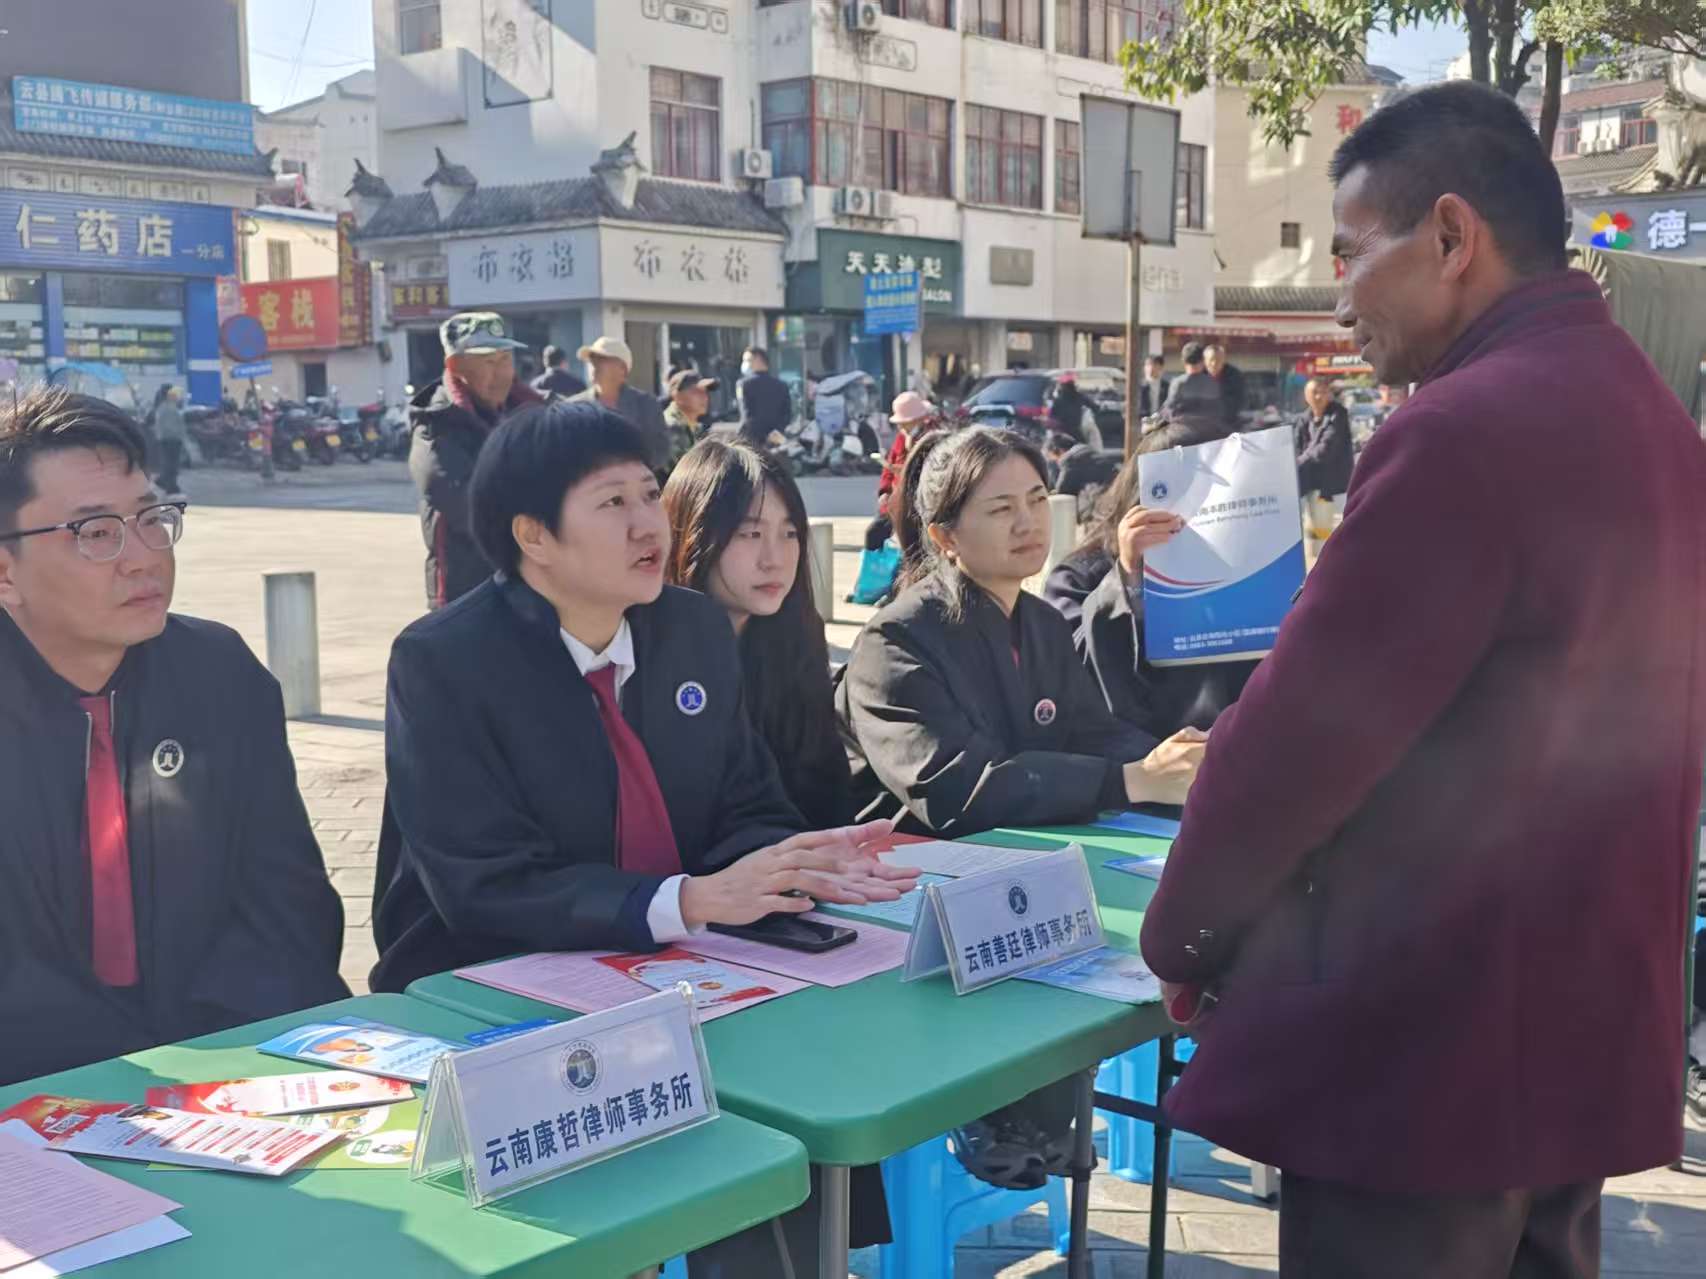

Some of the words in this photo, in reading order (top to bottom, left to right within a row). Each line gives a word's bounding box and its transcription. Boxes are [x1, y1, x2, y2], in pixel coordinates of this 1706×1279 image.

[16, 203, 173, 257] 仁药店
[239, 288, 316, 332] 客栈
[485, 1072, 693, 1177] 云南康哲律师事务所
